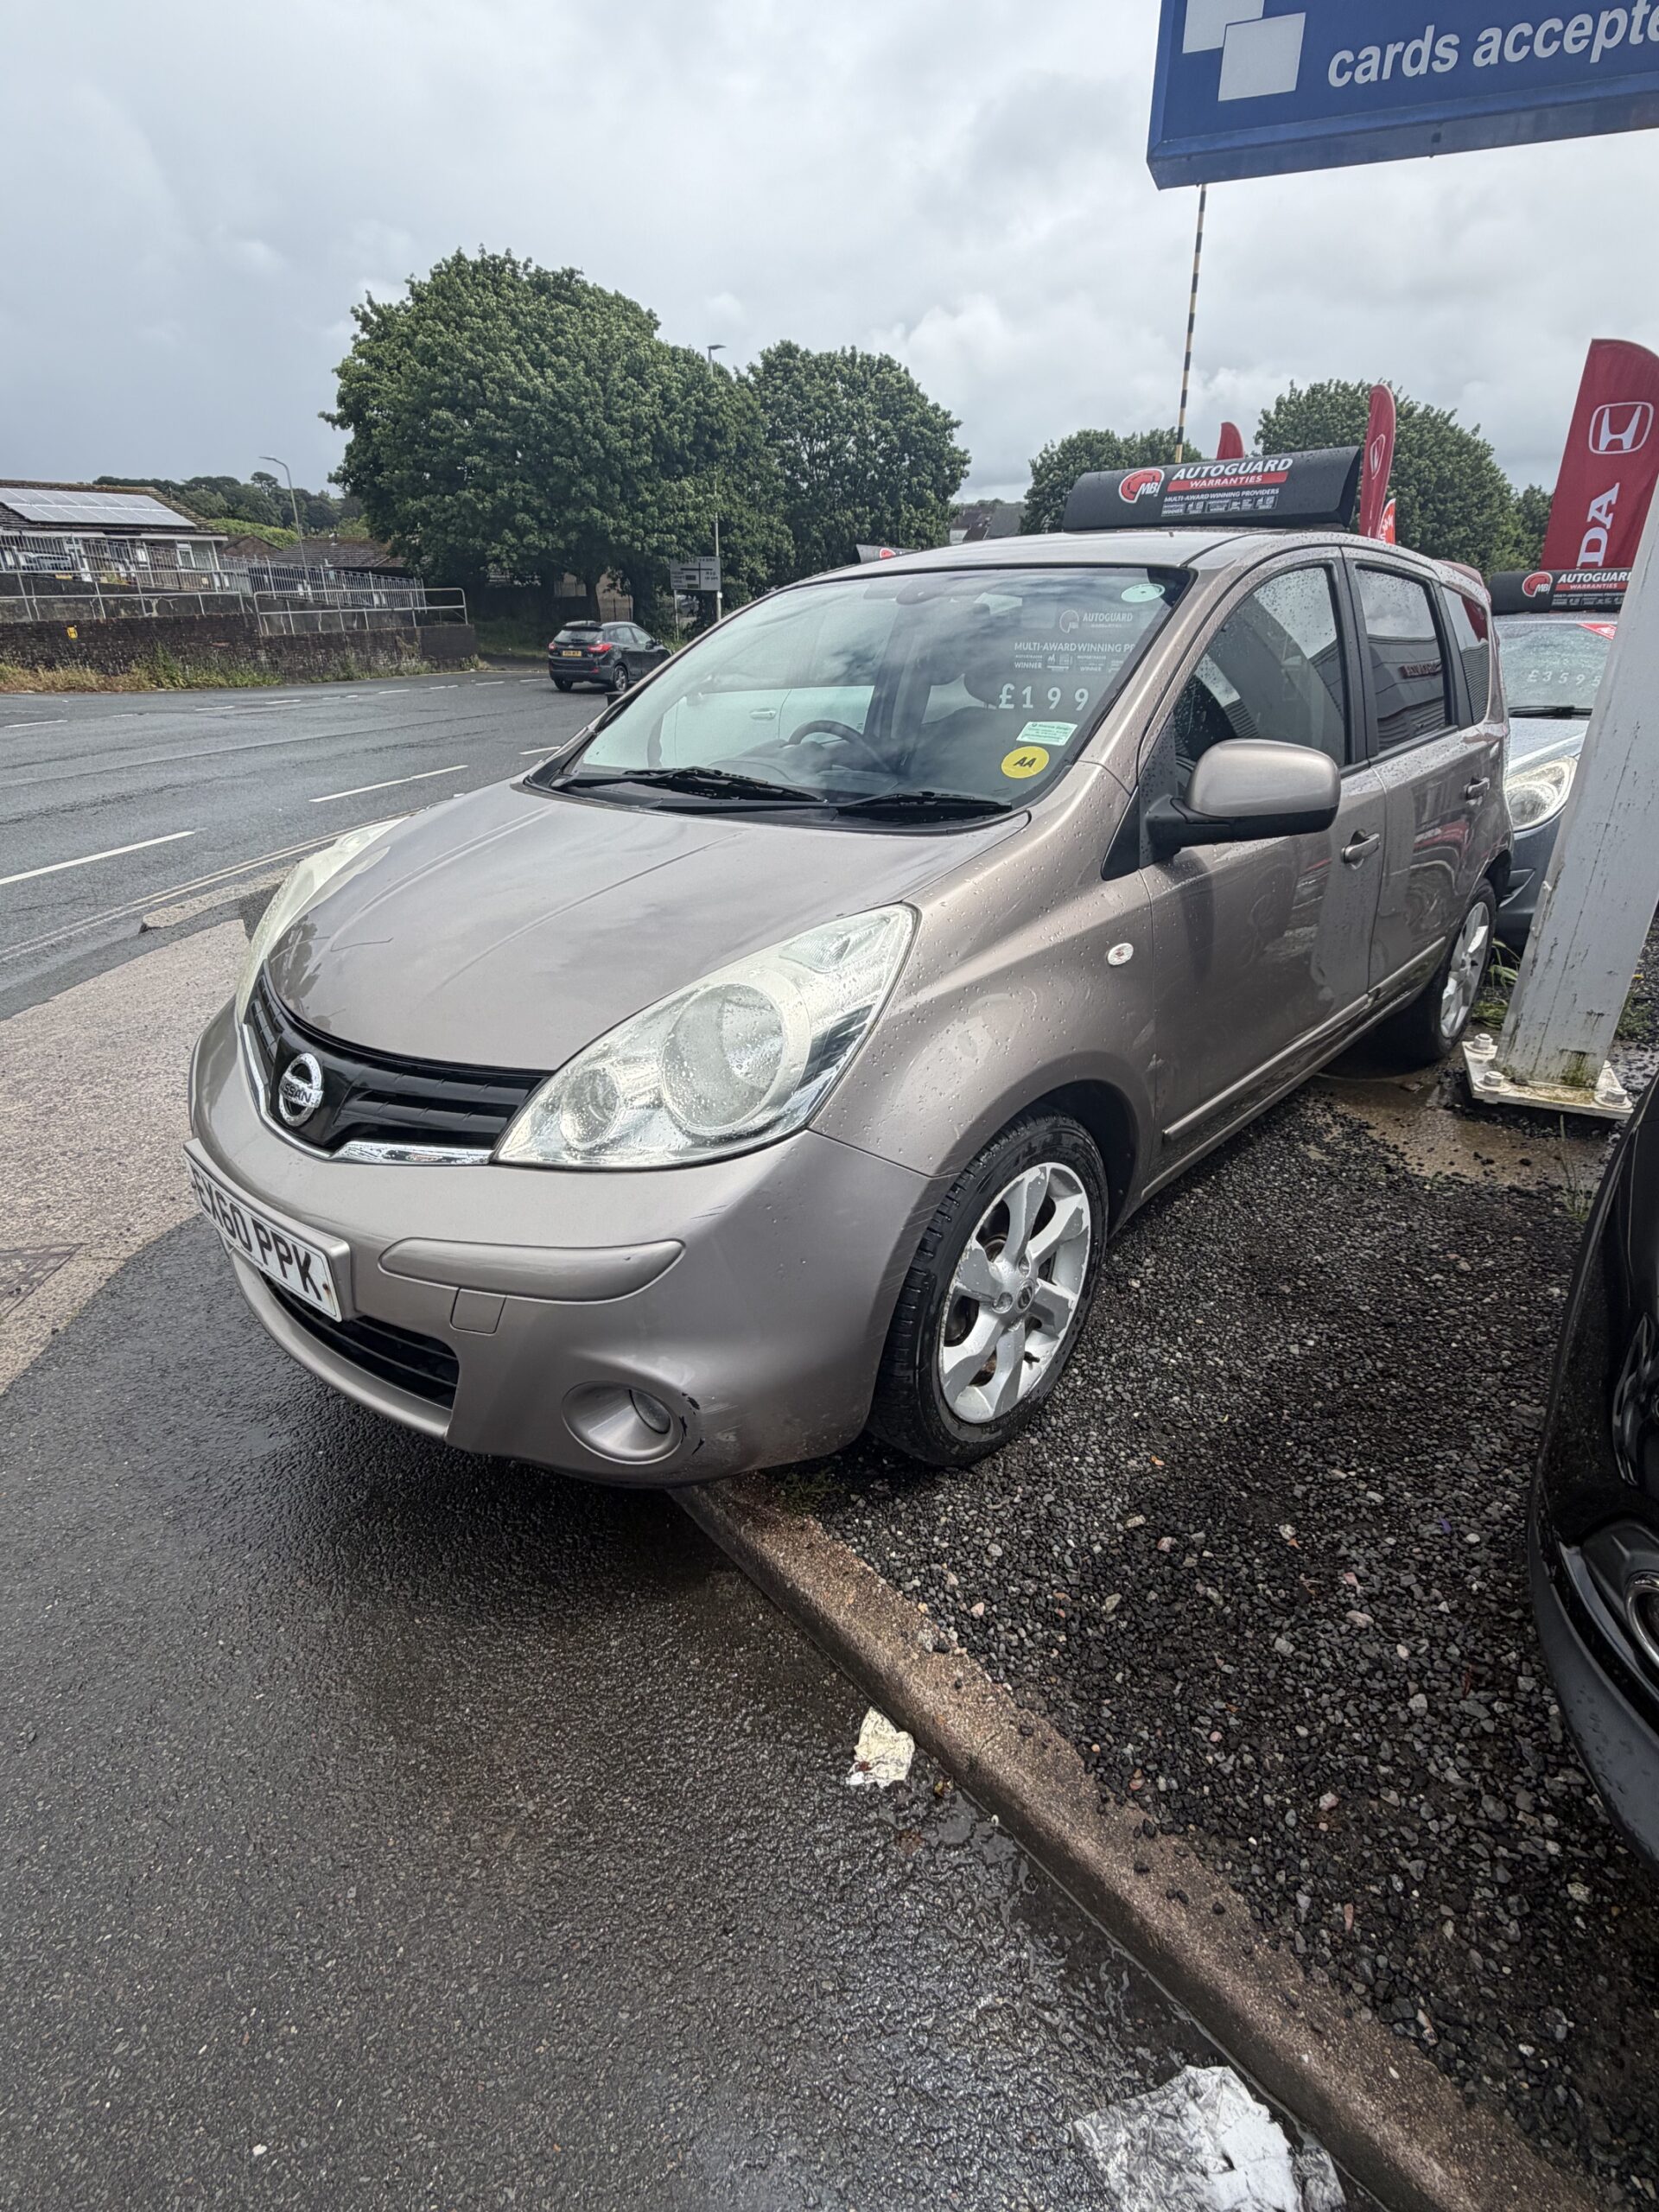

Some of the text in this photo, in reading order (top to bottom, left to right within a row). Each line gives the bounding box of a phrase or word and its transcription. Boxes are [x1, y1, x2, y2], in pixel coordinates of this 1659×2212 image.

[1327, 23, 1460, 88] cards
[1172, 458, 1294, 480] AUTOGUARD
[1189, 474, 1262, 488] WARRANTIES
[1164, 493, 1209, 502] MULTI-AWARD
[1241, 487, 1279, 496] PROVIDERS
[1083, 612, 1134, 622] AUTOGUARD
[1077, 643, 1122, 653] WINNING
[1014, 661, 1042, 670] WINNER
[1013, 756, 1038, 768] AA
[251, 1217, 322, 1301] PPK
